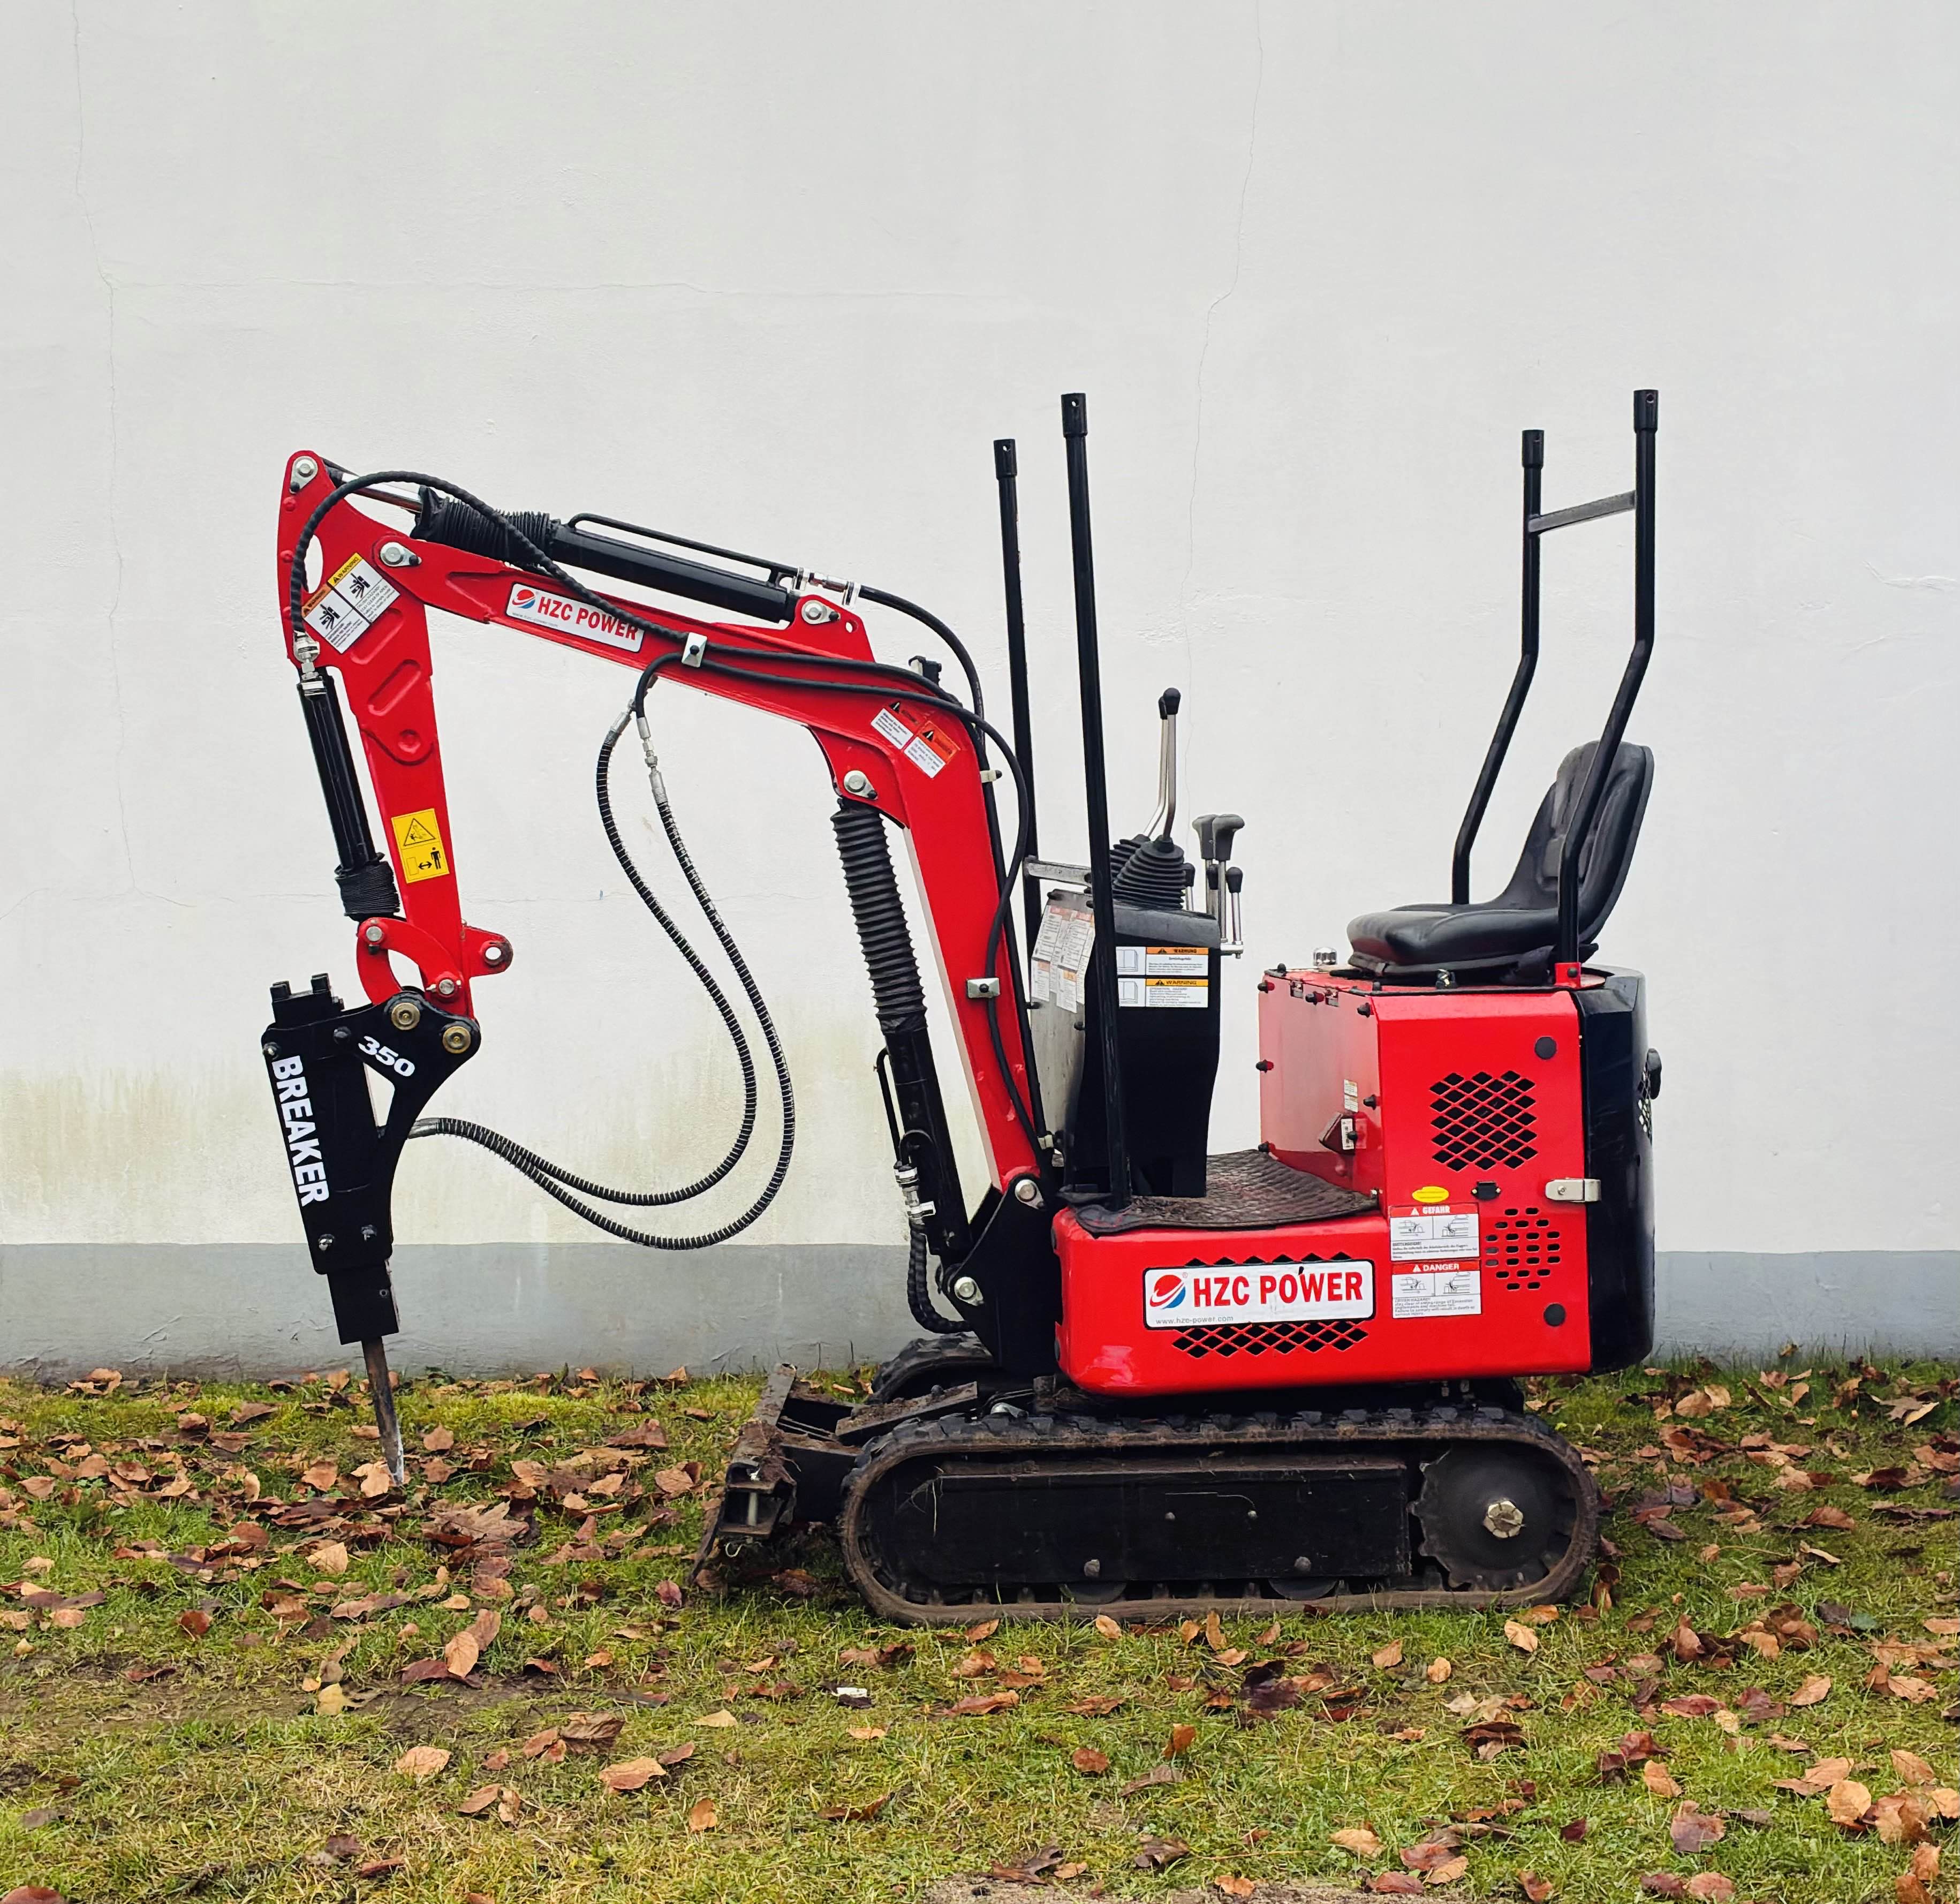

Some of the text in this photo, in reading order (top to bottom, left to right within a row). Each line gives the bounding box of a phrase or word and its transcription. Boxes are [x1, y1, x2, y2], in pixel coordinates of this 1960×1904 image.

[538, 596, 639, 640] HZC POWER
[358, 1036, 415, 1077] 350
[271, 1055, 329, 1206] BREAKER
[1422, 1205, 1450, 1214] GEFAHR
[1423, 1264, 1459, 1272] DANGER
[1193, 1272, 1363, 1307] HZC POWER
[1156, 1316, 1233, 1324] www.hzc-power.com
